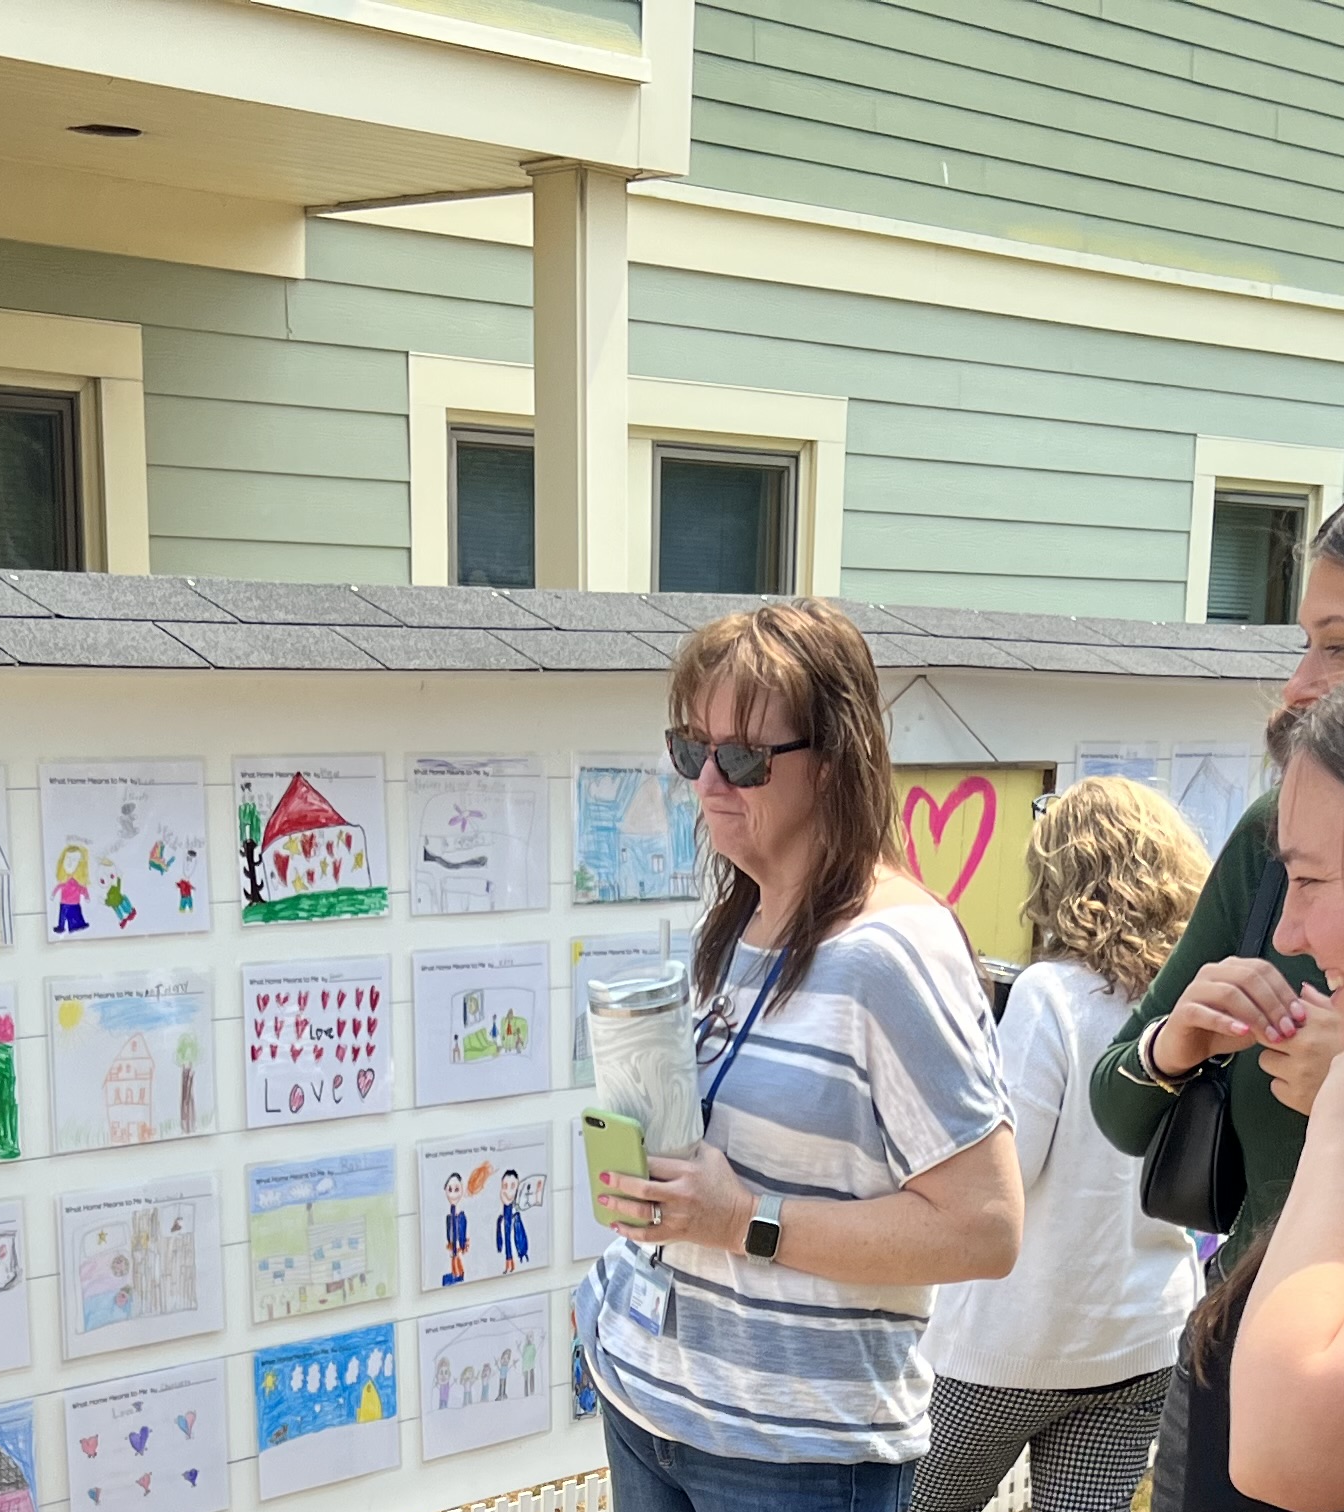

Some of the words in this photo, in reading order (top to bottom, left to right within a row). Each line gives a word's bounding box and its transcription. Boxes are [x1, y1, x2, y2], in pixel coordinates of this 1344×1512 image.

[65, 1206, 82, 1214] What
[83, 1203, 102, 1211] Home
[103, 1200, 125, 1209] Means
